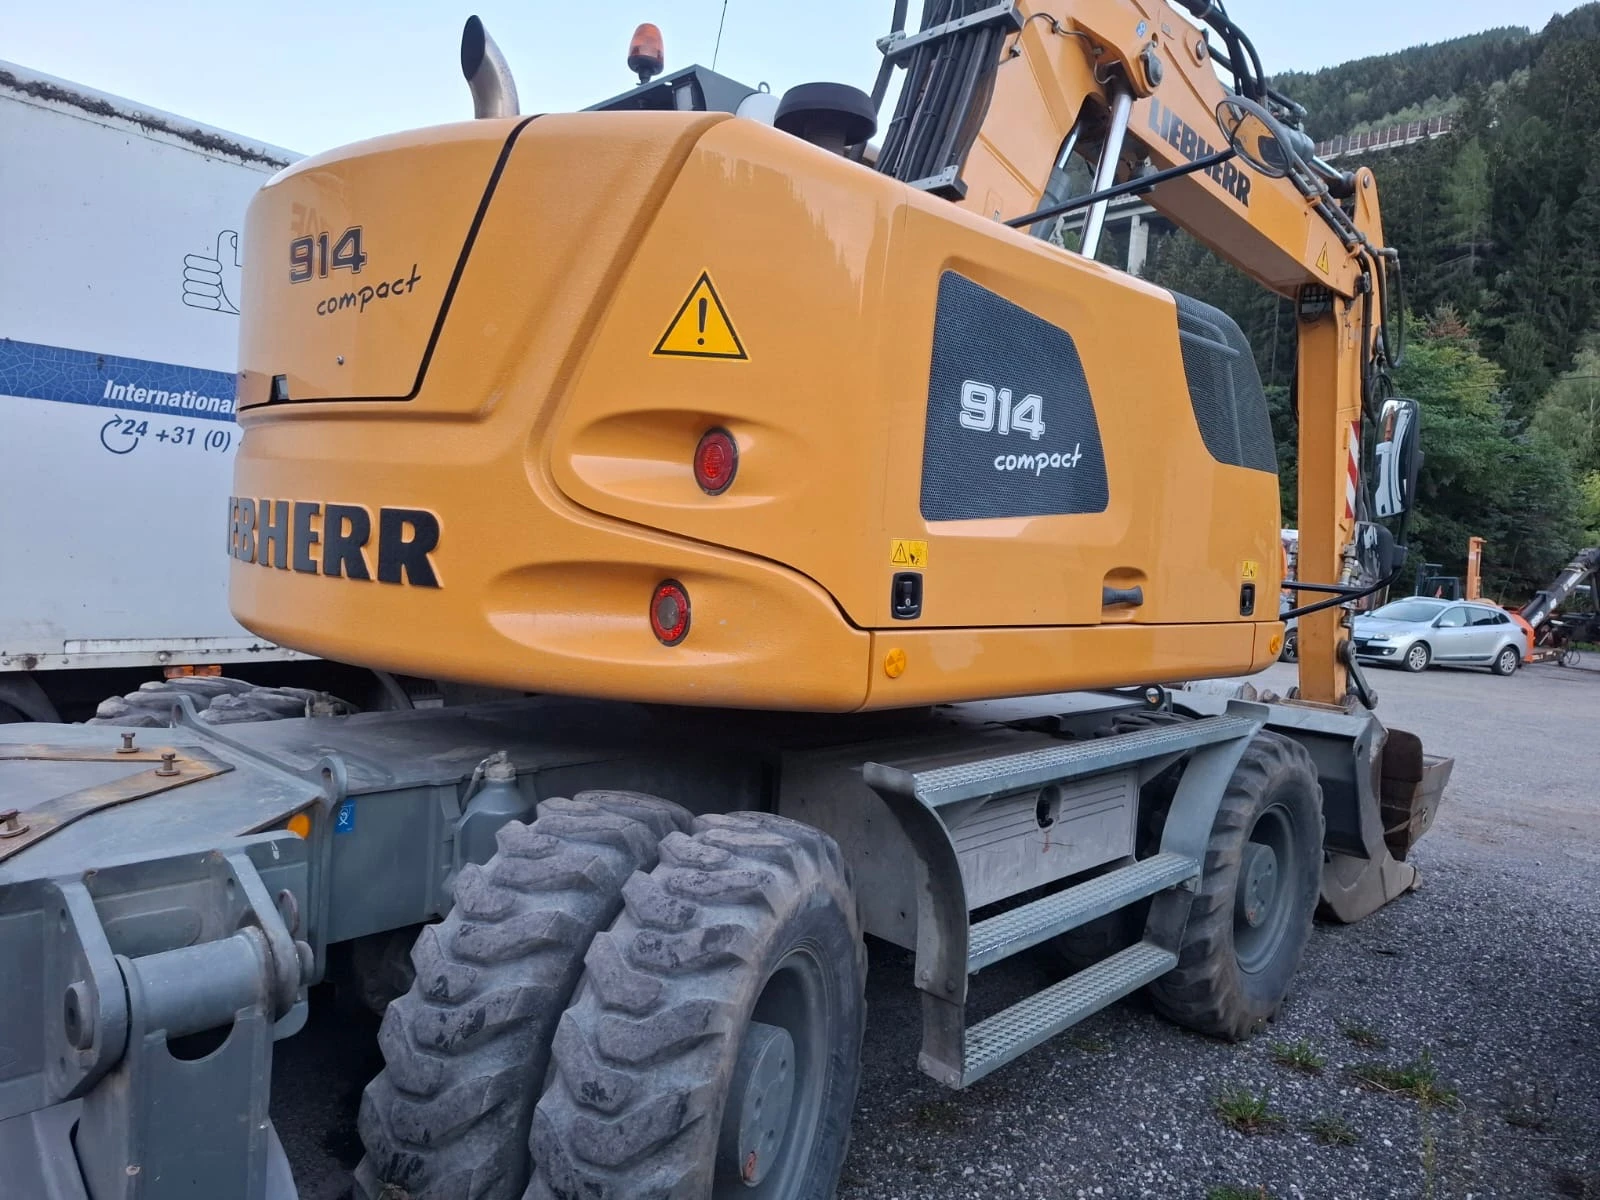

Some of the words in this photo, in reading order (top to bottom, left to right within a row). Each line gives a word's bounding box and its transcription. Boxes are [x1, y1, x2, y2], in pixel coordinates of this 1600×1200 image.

[289, 225, 368, 284] 914
[316, 263, 422, 316] compact
[121, 419, 149, 437] 24
[155, 426, 196, 445] +31
[204, 429, 231, 453] (0)
[960, 380, 1045, 440] 914
[994, 443, 1082, 476] compact
[227, 496, 443, 588] EBHERR
